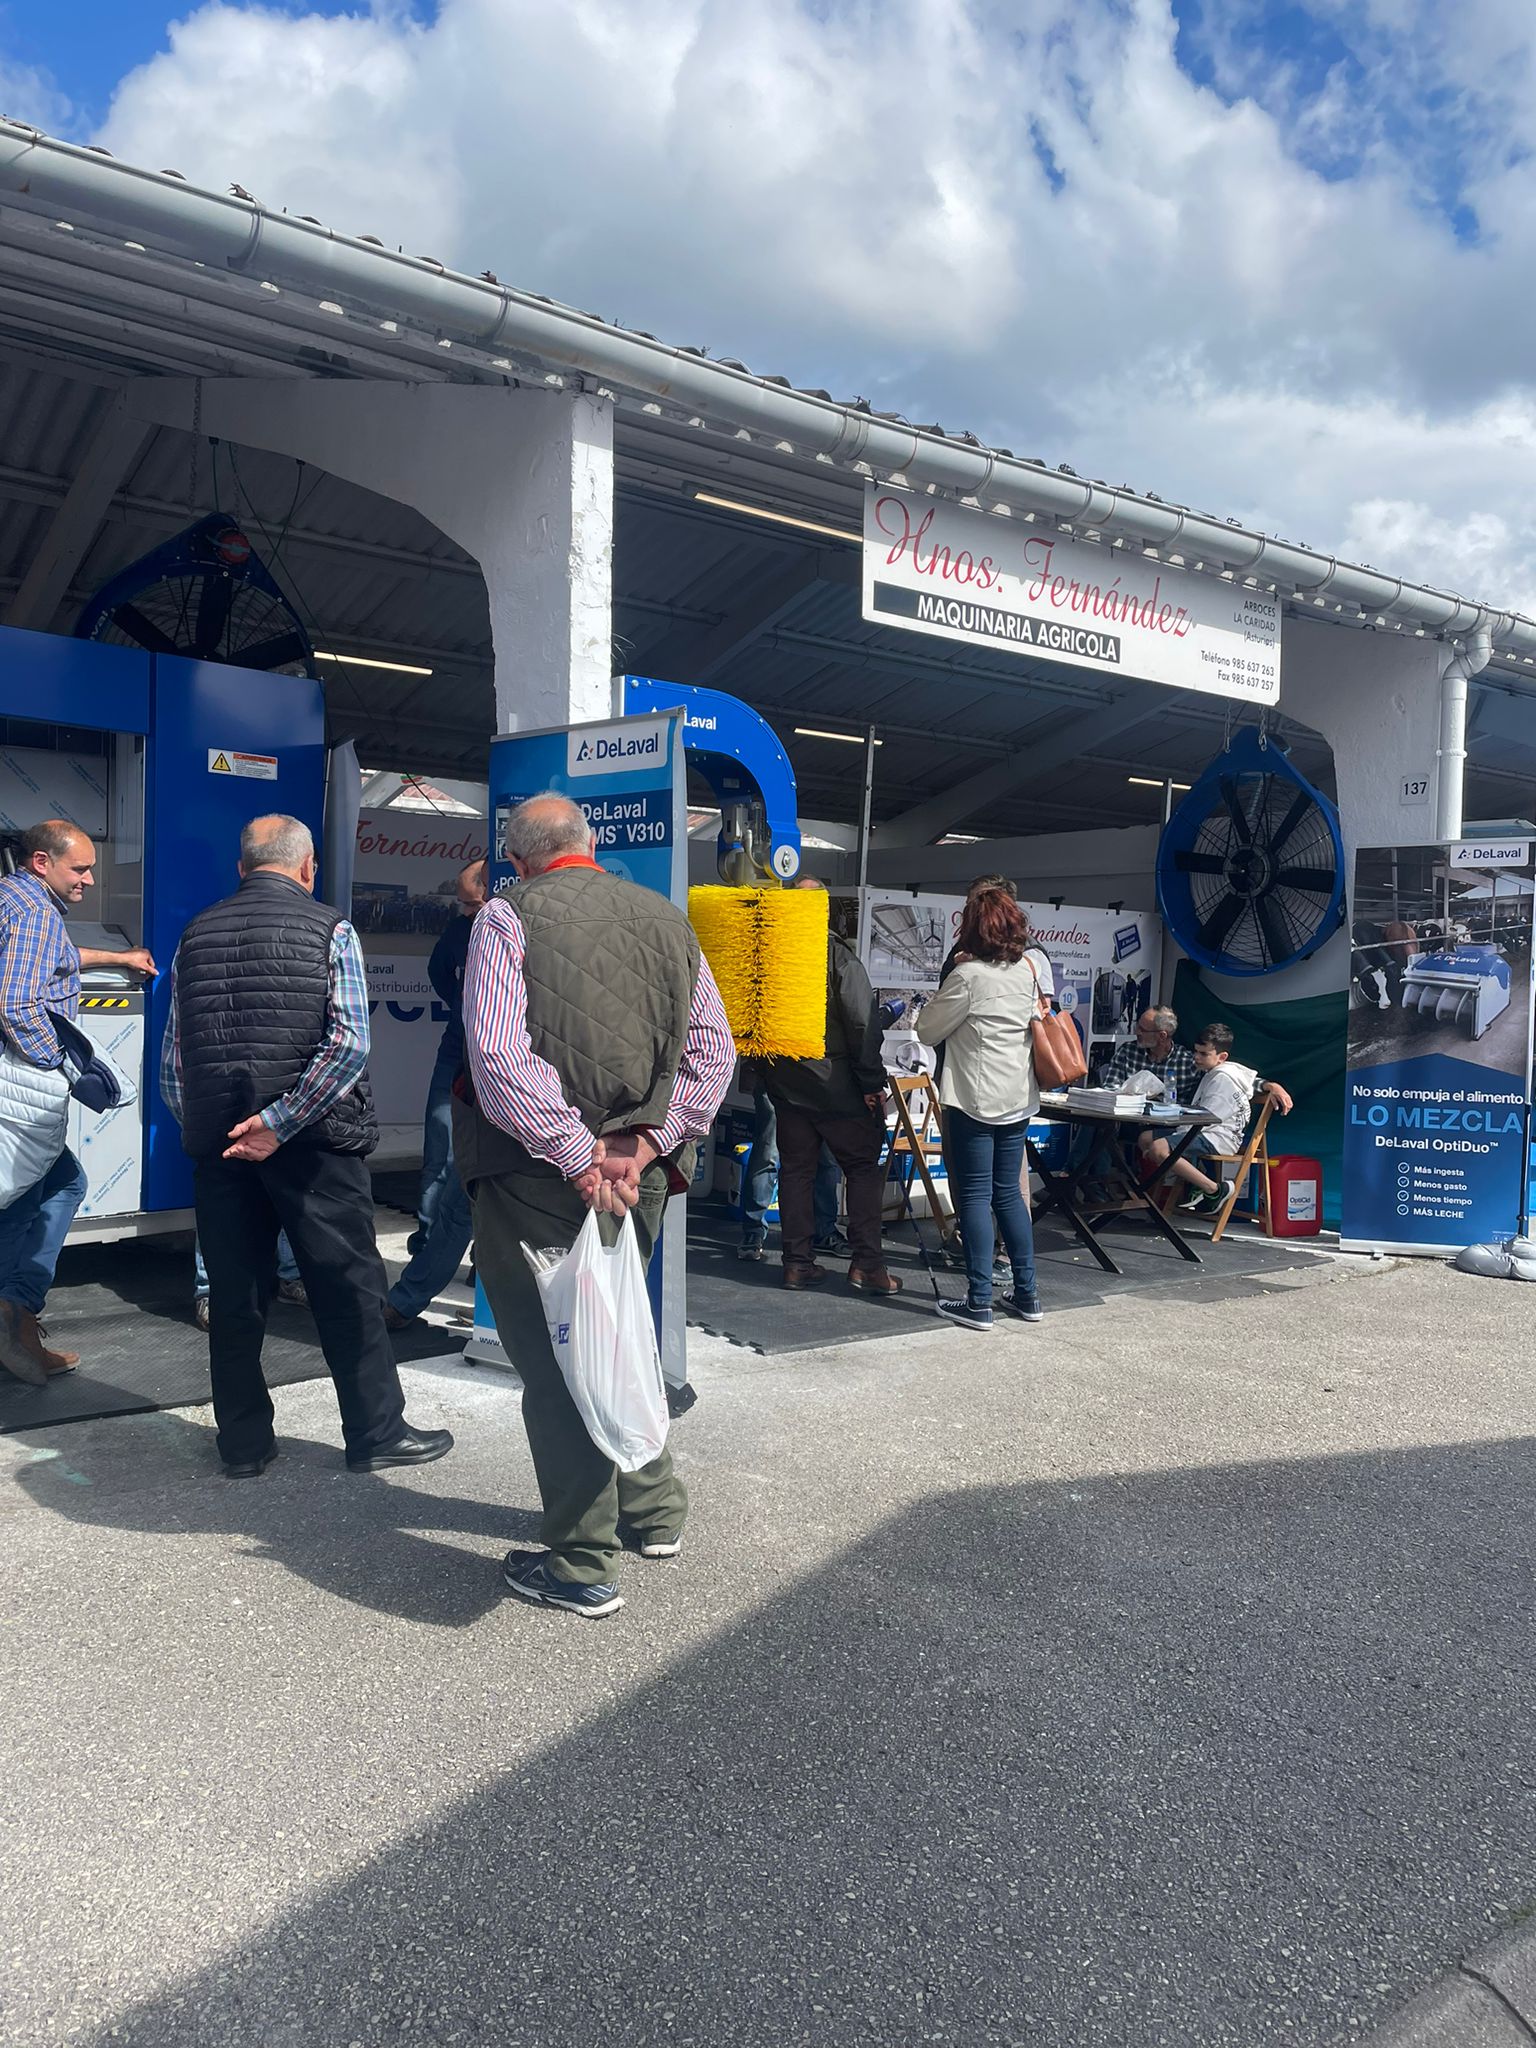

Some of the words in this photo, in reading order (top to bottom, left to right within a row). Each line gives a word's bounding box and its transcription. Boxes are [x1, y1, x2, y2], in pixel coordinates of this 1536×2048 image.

[875, 496, 1003, 593] Hnos.
[1023, 537, 1193, 638] Fernández
[1243, 600, 1276, 618] ARBOCES
[917, 594, 1033, 643] MAQUINARIA
[1036, 622, 1118, 661] AGRICOLA
[1233, 612, 1242, 624] LA
[1244, 615, 1276, 632] CARIDAD
[1243, 630, 1275, 649] (Asturias)
[1201, 650, 1231, 667] Teléfono
[1232, 657, 1245, 670] 985
[1246, 661, 1260, 673] 637
[1261, 664, 1275, 677] 263
[1217, 669, 1230, 682] Fax
[1231, 672, 1245, 685] 985
[1246, 676, 1260, 688] 637
[1261, 679, 1274, 691] 257
[683, 712, 717, 730] Laval
[596, 732, 659, 759] DeLaval
[1403, 781, 1428, 796] 137
[580, 798, 647, 821] DeLaval
[356, 820, 488, 861] Fernánde
[626, 821, 665, 843] V310
[1473, 848, 1521, 859] DeLaval
[1027, 922, 1091, 945] rnández
[365, 963, 394, 974] Laval
[1444, 955, 1480, 964] DeLaval
[1062, 992, 1073, 1004] 10
[1353, 1085, 1371, 1097] No
[1373, 1086, 1400, 1099] solo
[1402, 1088, 1450, 1103] empuja
[1452, 1090, 1464, 1102] el
[1466, 1090, 1524, 1105] alimento
[1351, 1104, 1389, 1127] LO
[1396, 1106, 1523, 1134] MEZCLA
[1375, 1135, 1429, 1150] DeLaval
[1414, 1165, 1432, 1174] Más
[1433, 1167, 1464, 1177] ingesta
[1413, 1180, 1442, 1189] Menos
[1443, 1183, 1468, 1191] gasto
[1413, 1194, 1442, 1203] Menos
[1443, 1196, 1473, 1206] tiempo
[1413, 1207, 1433, 1217] MÁS
[1434, 1209, 1465, 1219] LECHE
